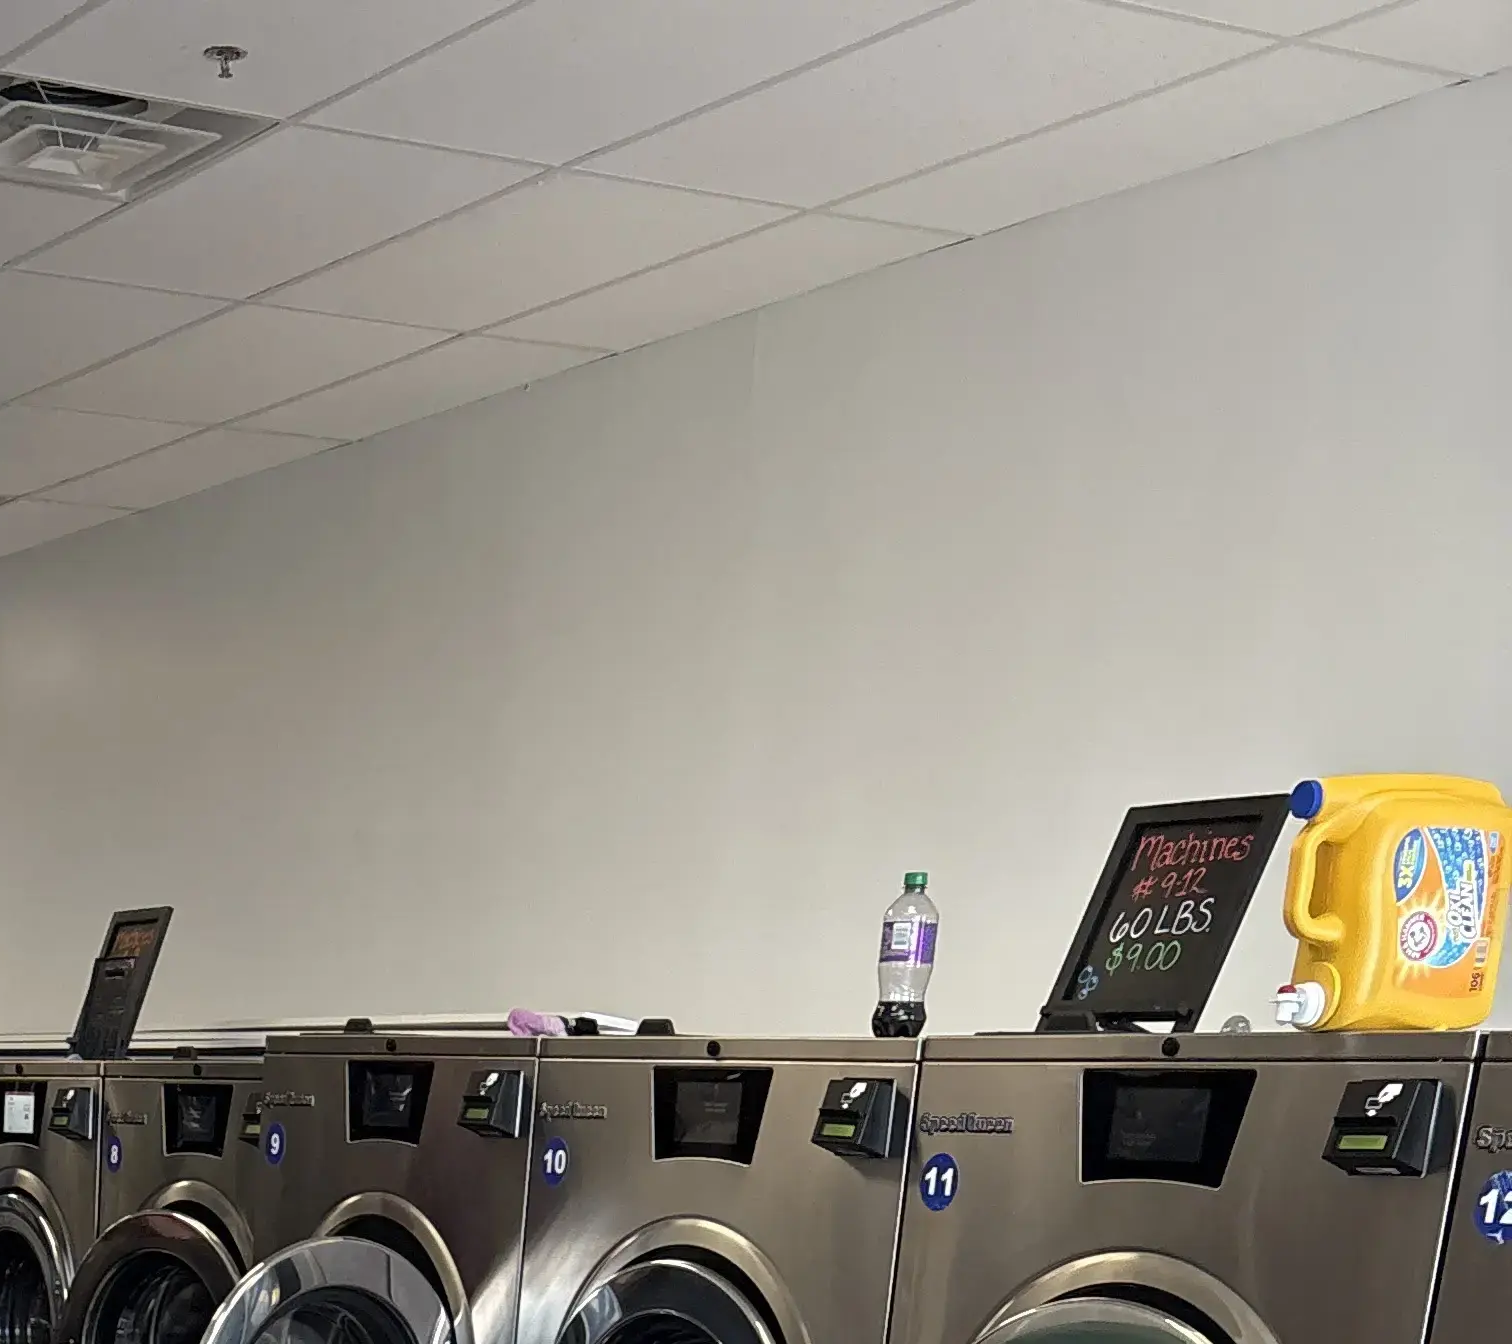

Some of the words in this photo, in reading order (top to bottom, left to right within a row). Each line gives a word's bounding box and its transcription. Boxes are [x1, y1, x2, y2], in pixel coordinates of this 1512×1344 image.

[1131, 830, 1254, 871] Machines
[1109, 907, 1153, 943] 60
[1105, 940, 1182, 976] $9.00
[110, 1144, 119, 1164] 8
[270, 1132, 280, 1155] 9
[544, 1148, 567, 1174] 10
[924, 1166, 954, 1196] 11
